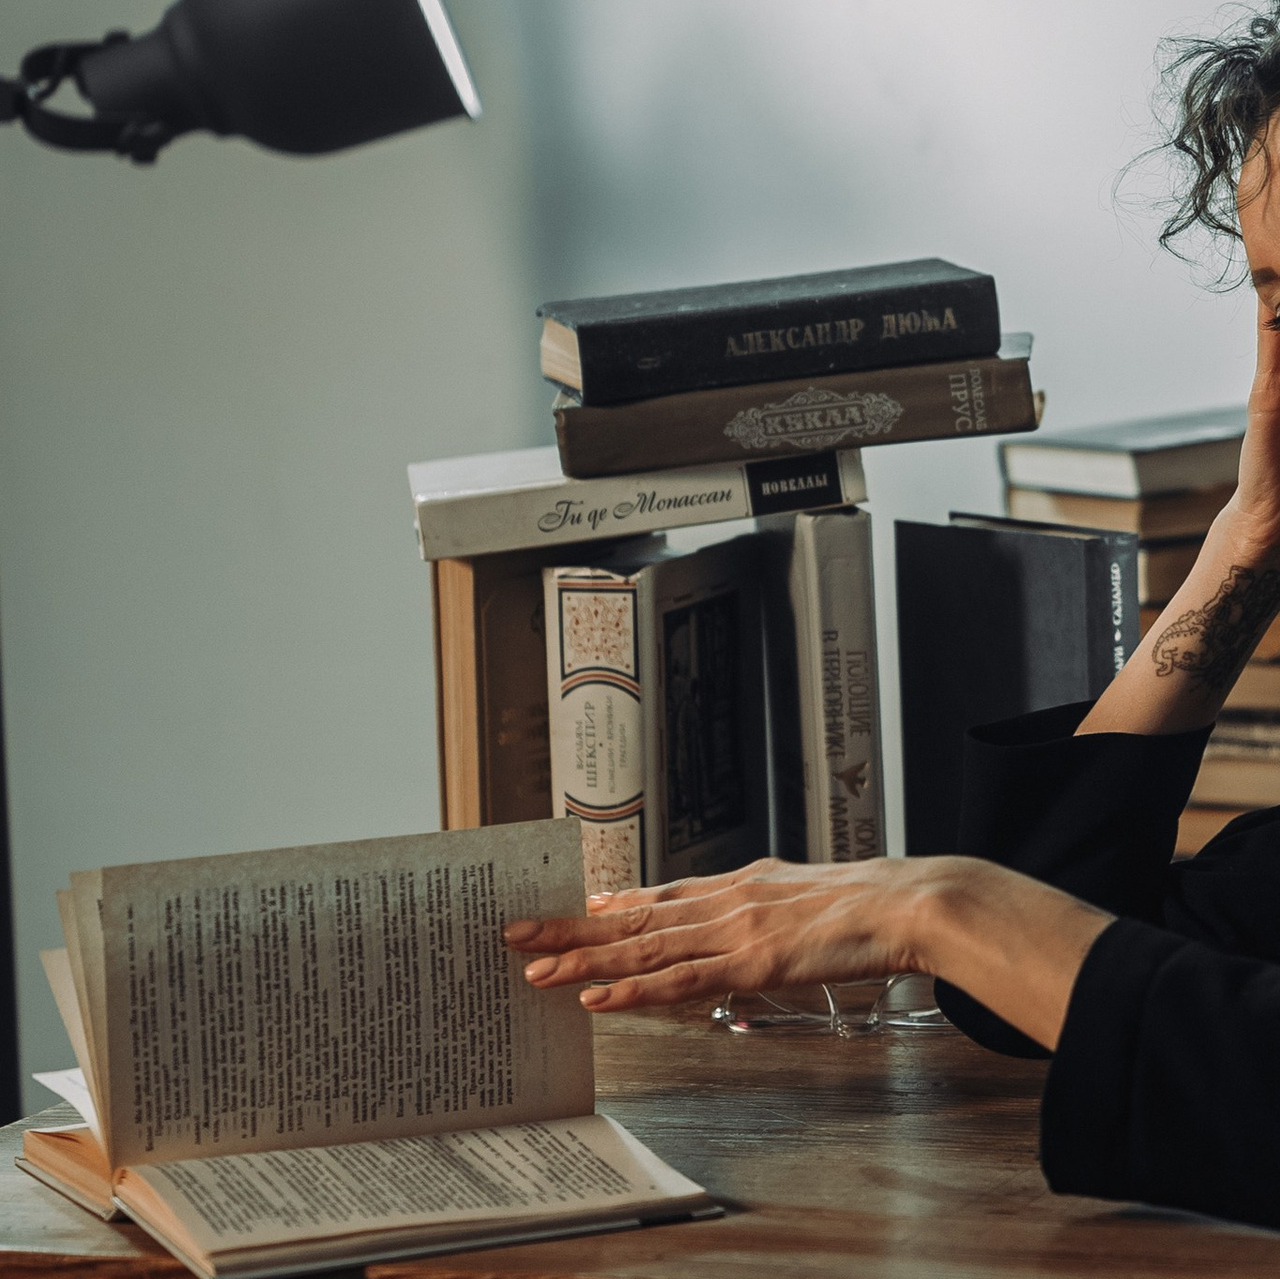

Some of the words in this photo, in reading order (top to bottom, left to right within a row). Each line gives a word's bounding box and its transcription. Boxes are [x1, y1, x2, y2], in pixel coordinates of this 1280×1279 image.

[725, 318, 865, 358] АЛЕКСАНДР
[882, 307, 958, 339] ДЮМА
[948, 373, 973, 432] ПРУС
[612, 489, 733, 520] Мопассан
[761, 473, 828, 497] НОВЕЛЛЫ
[846, 650, 871, 737] ПОЮЩИЕ
[584, 702, 598, 788] ШЕКСПИР
